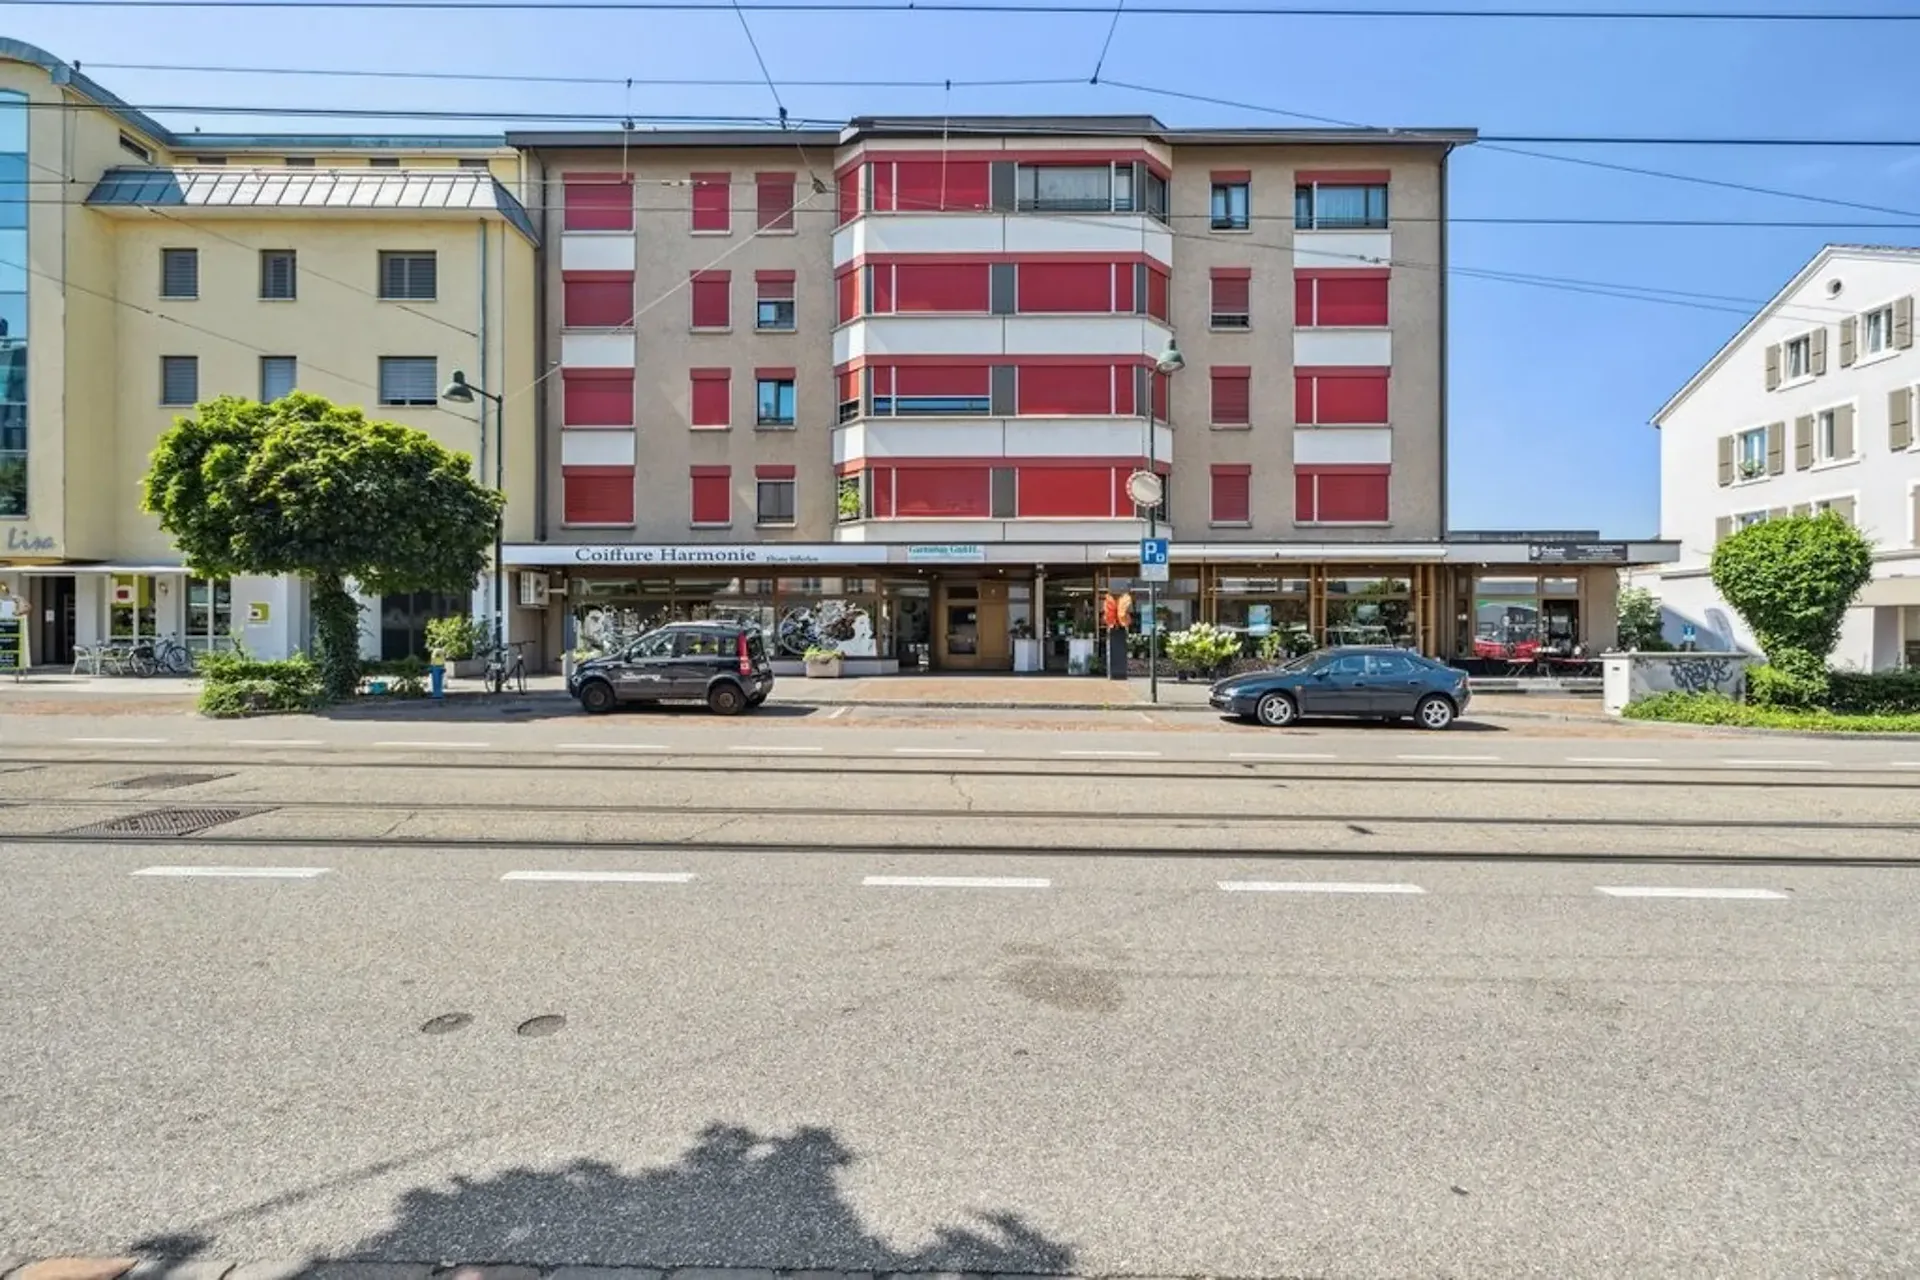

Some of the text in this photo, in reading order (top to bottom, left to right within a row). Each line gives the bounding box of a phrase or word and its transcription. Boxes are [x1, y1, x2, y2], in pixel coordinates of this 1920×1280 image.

[576, 546, 757, 563] Coiffure Harmonie
[1145, 541, 1158, 561] P
